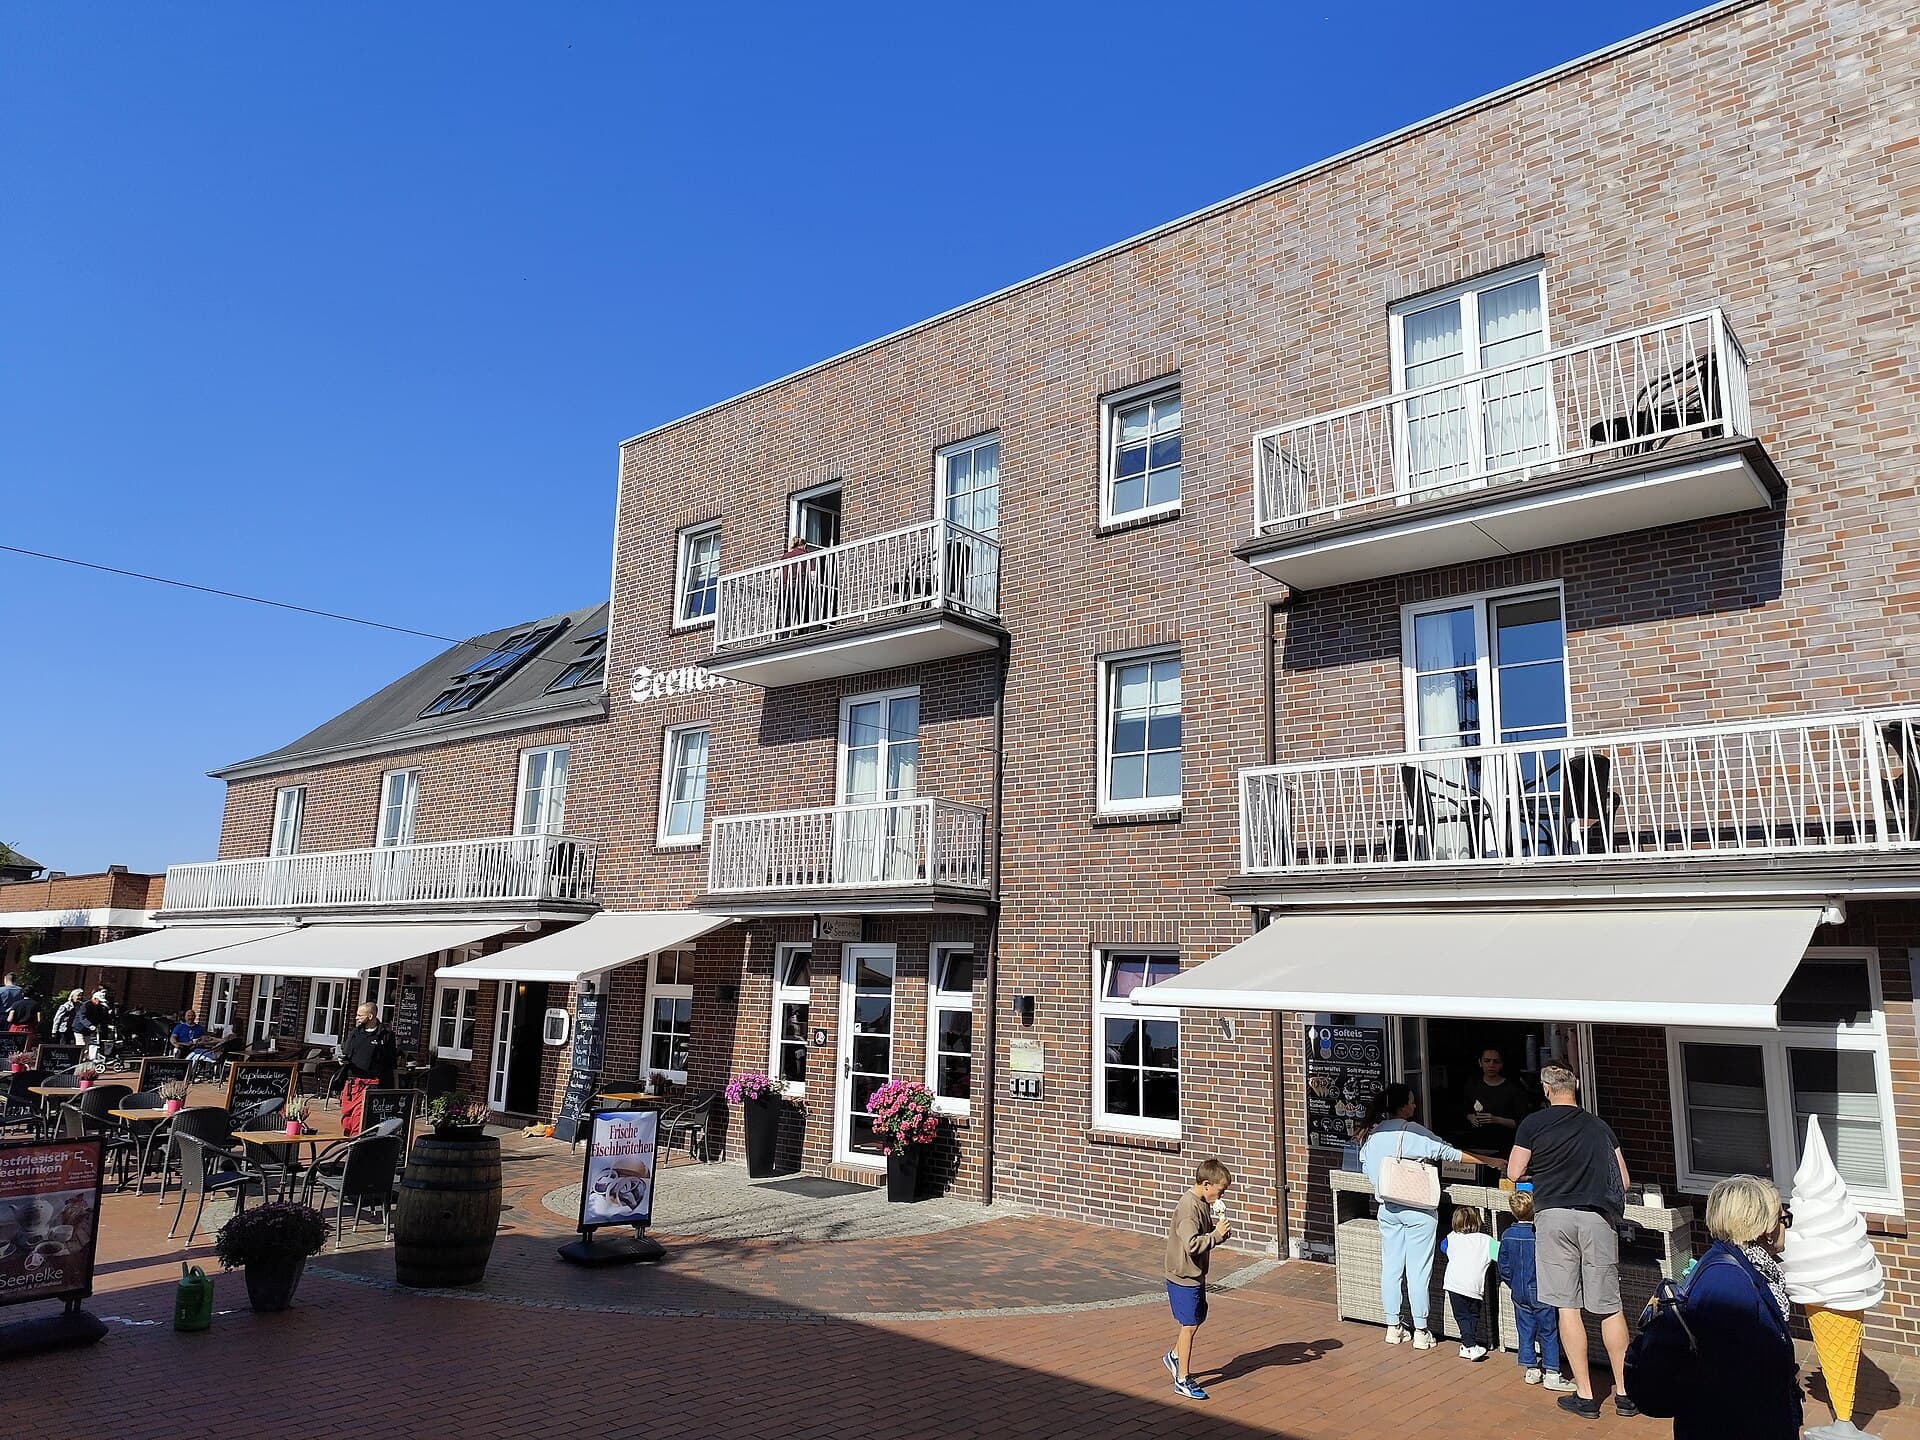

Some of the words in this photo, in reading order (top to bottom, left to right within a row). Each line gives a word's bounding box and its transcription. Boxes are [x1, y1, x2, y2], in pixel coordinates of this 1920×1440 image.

[1333, 1028, 1363, 1038] Softeis
[372, 1098, 394, 1111] Roter
[609, 1123, 639, 1140] Frische
[591, 1140, 654, 1157] Fischbrötchen
